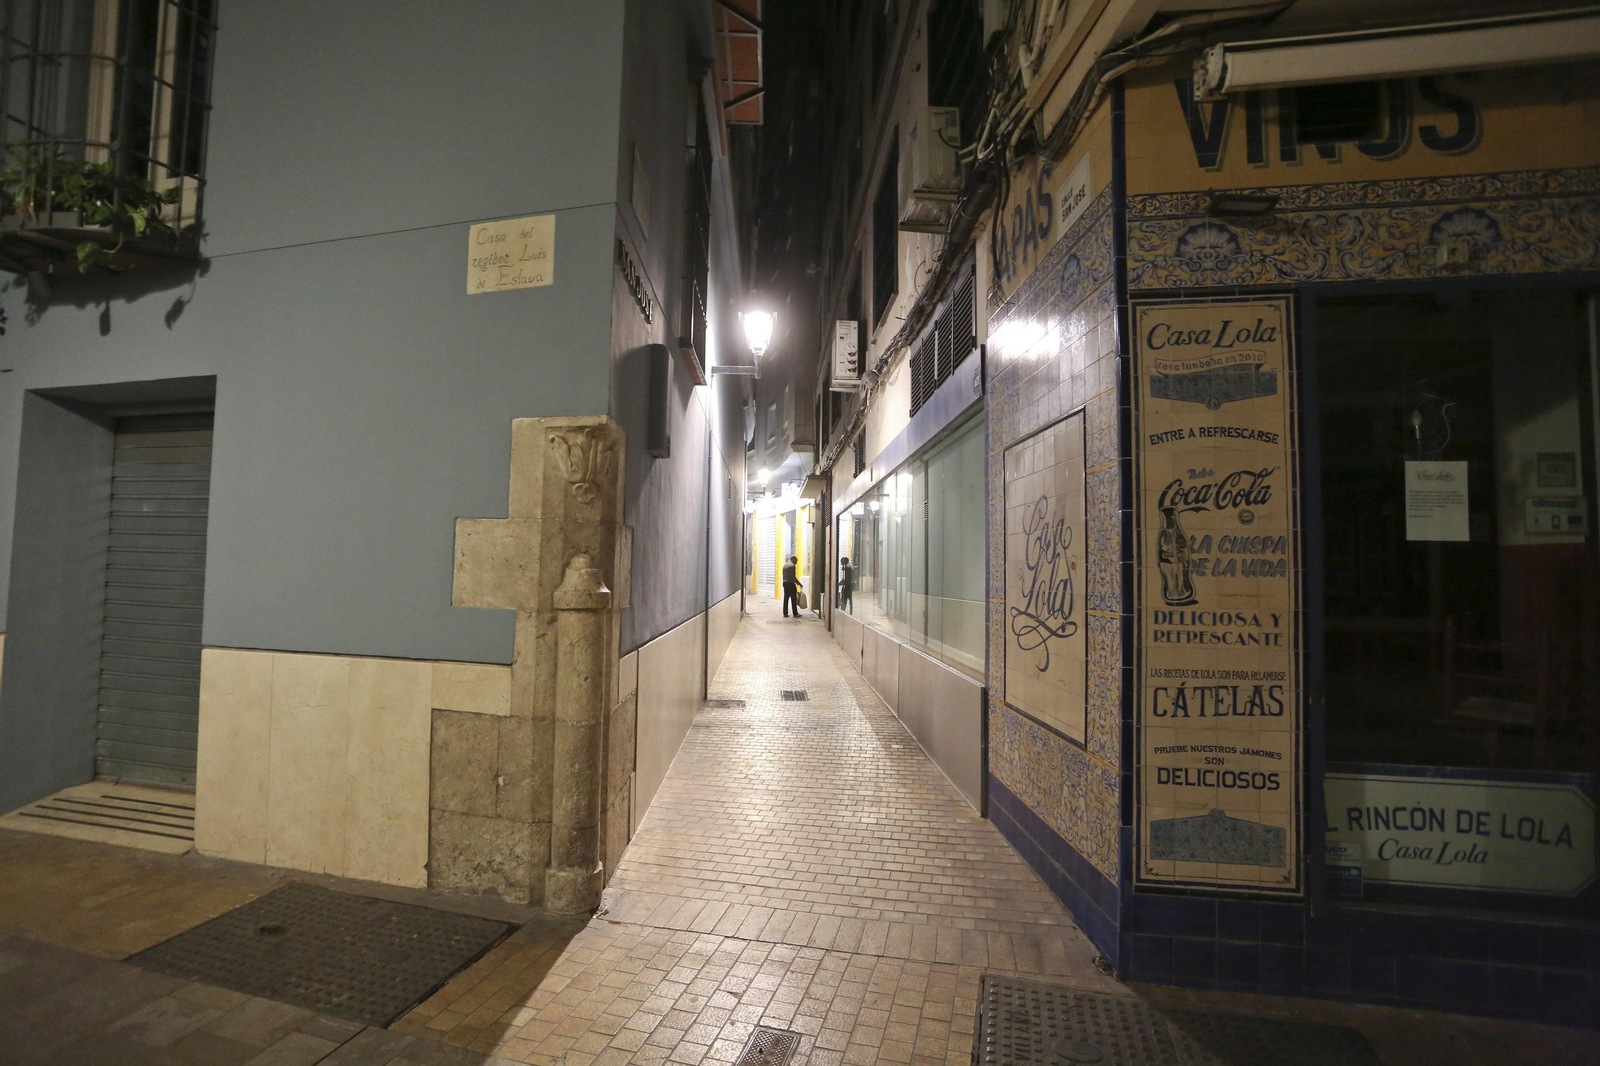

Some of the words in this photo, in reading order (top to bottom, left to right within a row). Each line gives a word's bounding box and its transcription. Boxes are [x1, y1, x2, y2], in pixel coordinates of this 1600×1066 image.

[989, 163, 1053, 287] APAS
[477, 228, 507, 245] Casa
[519, 226, 535, 239] del
[518, 244, 547, 262] Luis
[475, 278, 486, 289] de
[495, 264, 544, 287] Eslava
[1146, 323, 1211, 350] Casa
[1212, 318, 1277, 349] Lola
[1157, 361, 1180, 372] casa
[1180, 357, 1224, 371] fundada
[1224, 354, 1237, 364] en
[1238, 352, 1264, 363] 2010
[1149, 428, 1185, 446] ENTRE
[1188, 427, 1196, 439] A
[1198, 426, 1280, 445] REFRESCARSE
[1158, 466, 1277, 512] Coca-Cola
[1188, 534, 1213, 555] LA
[1217, 535, 1287, 555] CHISPA
[1211, 558, 1237, 577] LA
[1241, 558, 1287, 578] VIDA
[1153, 609, 1262, 628] DELICIOSA
[1270, 613, 1283, 628] Y
[1153, 629, 1283, 647] REFRESCANTE
[1150, 668, 1162, 678] LAS
[1163, 668, 1190, 679] RECETAS
[1191, 669, 1200, 679] DE
[1201, 669, 1216, 680] LOLA
[1217, 670, 1231, 680] SON
[1232, 670, 1250, 680] PARA
[1250, 670, 1287, 681] RELAMERSE
[1153, 681, 1285, 718] CÁTELAS
[1154, 745, 1188, 754] PRUEBE
[1190, 745, 1237, 754] NUESTROS
[1239, 747, 1282, 760] JAMONES
[1204, 757, 1225, 766] SON
[1157, 767, 1280, 791] DELICIOSOS
[1346, 801, 1446, 833] RINCÓN
[1456, 809, 1491, 837] DE
[1500, 814, 1574, 849] LOLA
[1378, 838, 1434, 862] Casa
[1432, 841, 1488, 865] Lola
